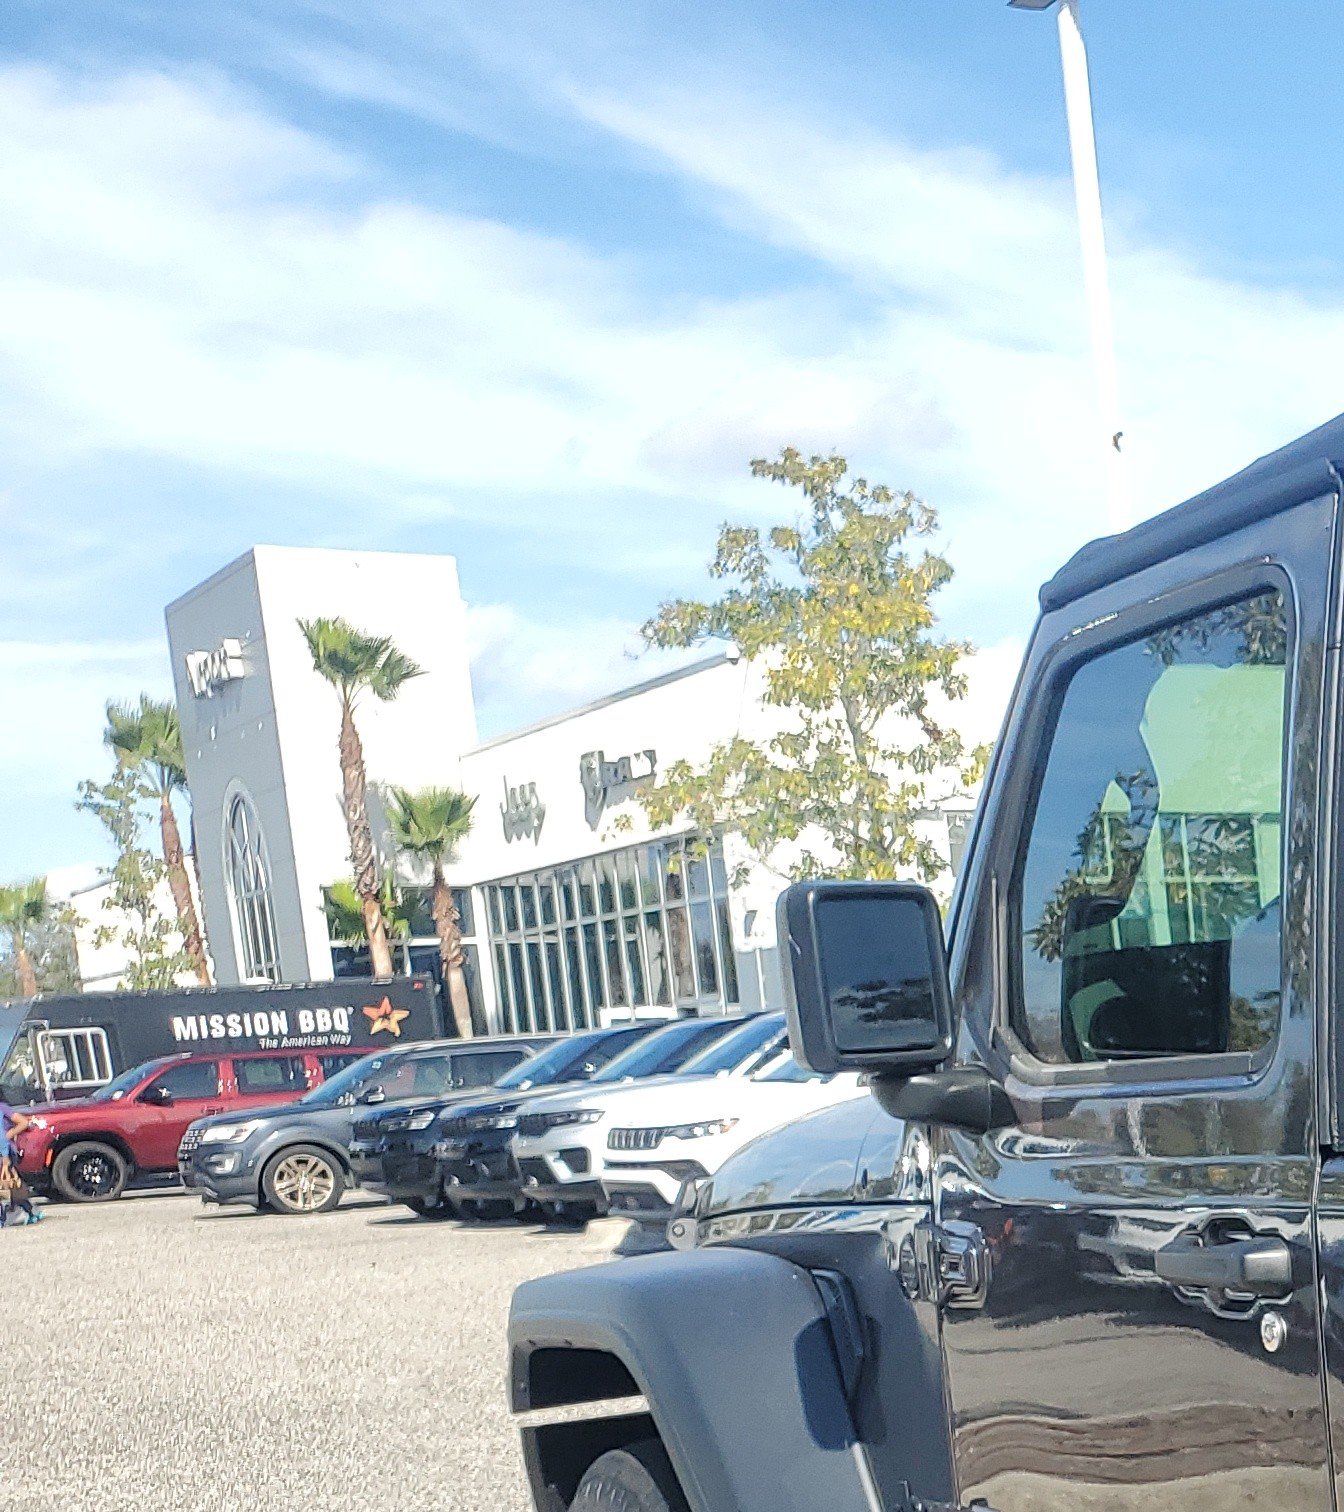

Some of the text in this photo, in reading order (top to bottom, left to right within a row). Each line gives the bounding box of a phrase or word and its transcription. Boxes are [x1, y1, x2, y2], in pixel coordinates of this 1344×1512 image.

[172, 1006, 351, 1041] MISSION BBQ
[259, 1033, 351, 1050] The American Way
